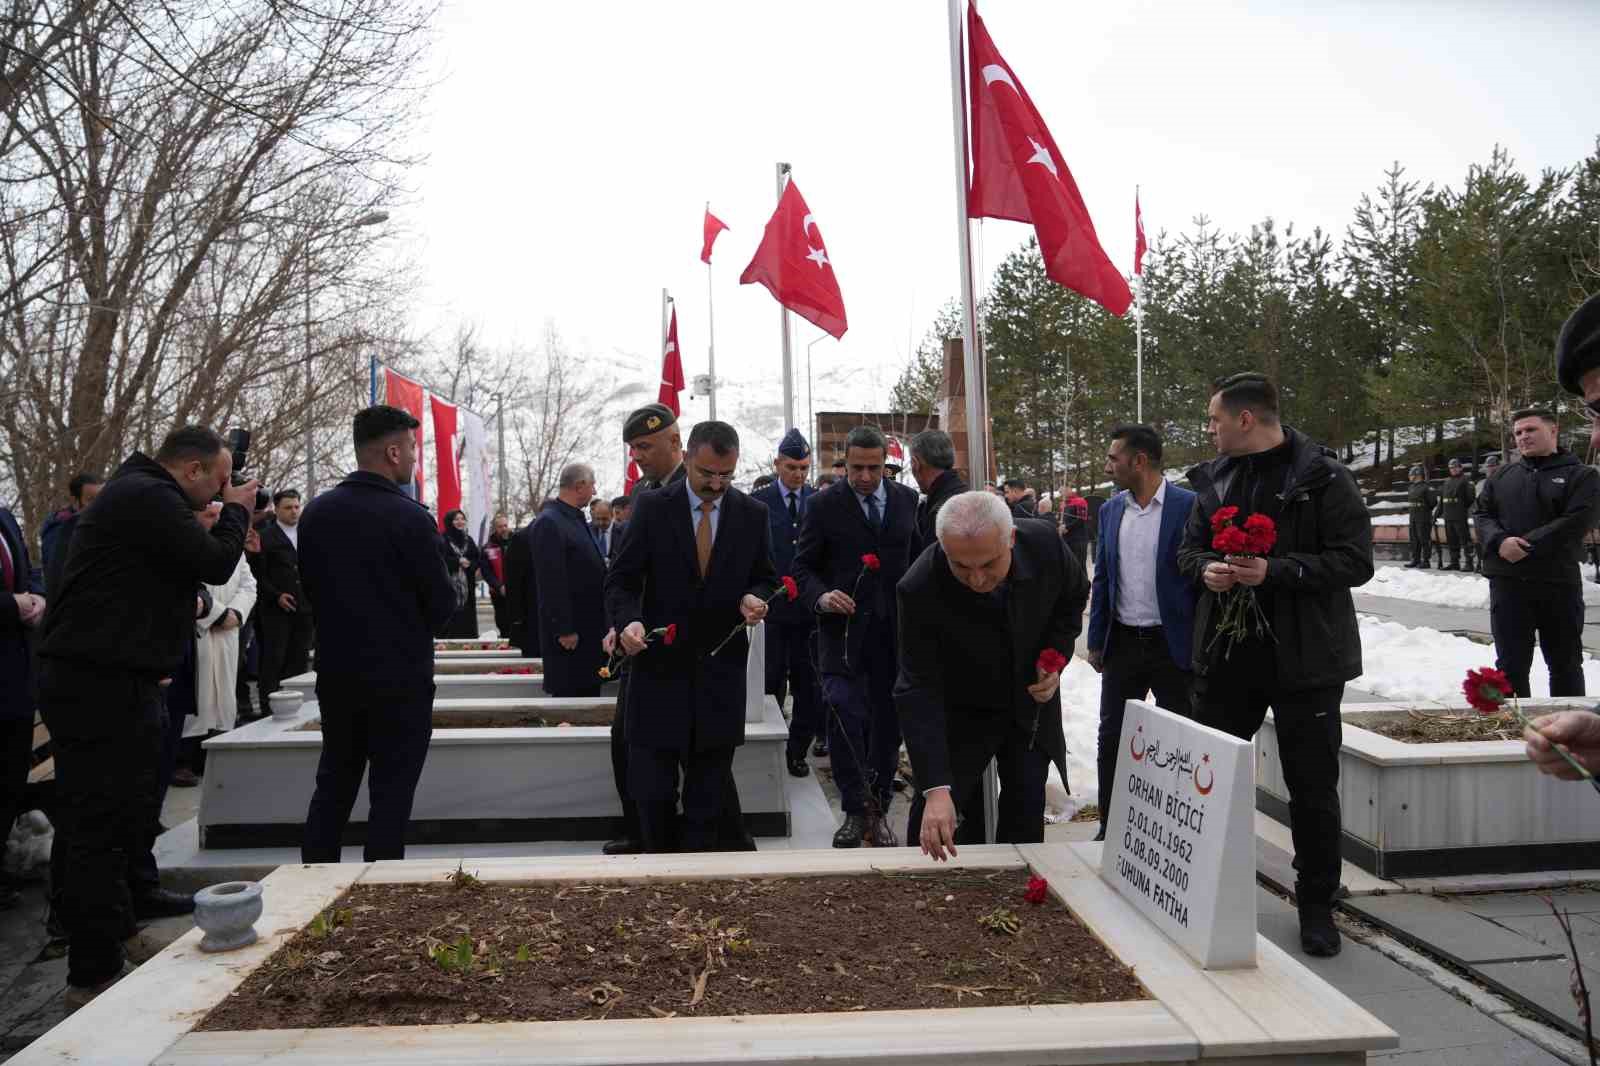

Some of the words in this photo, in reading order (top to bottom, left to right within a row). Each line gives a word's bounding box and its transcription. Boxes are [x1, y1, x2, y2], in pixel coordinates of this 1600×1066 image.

[1128, 774, 1163, 810] ORHAN
[1165, 790, 1204, 834] BİÇİCİ
[1124, 825, 1189, 891] Ö.08.09.2000
[1128, 806, 1193, 863] D.01.01.1962
[1153, 883, 1188, 928] FATİHA
